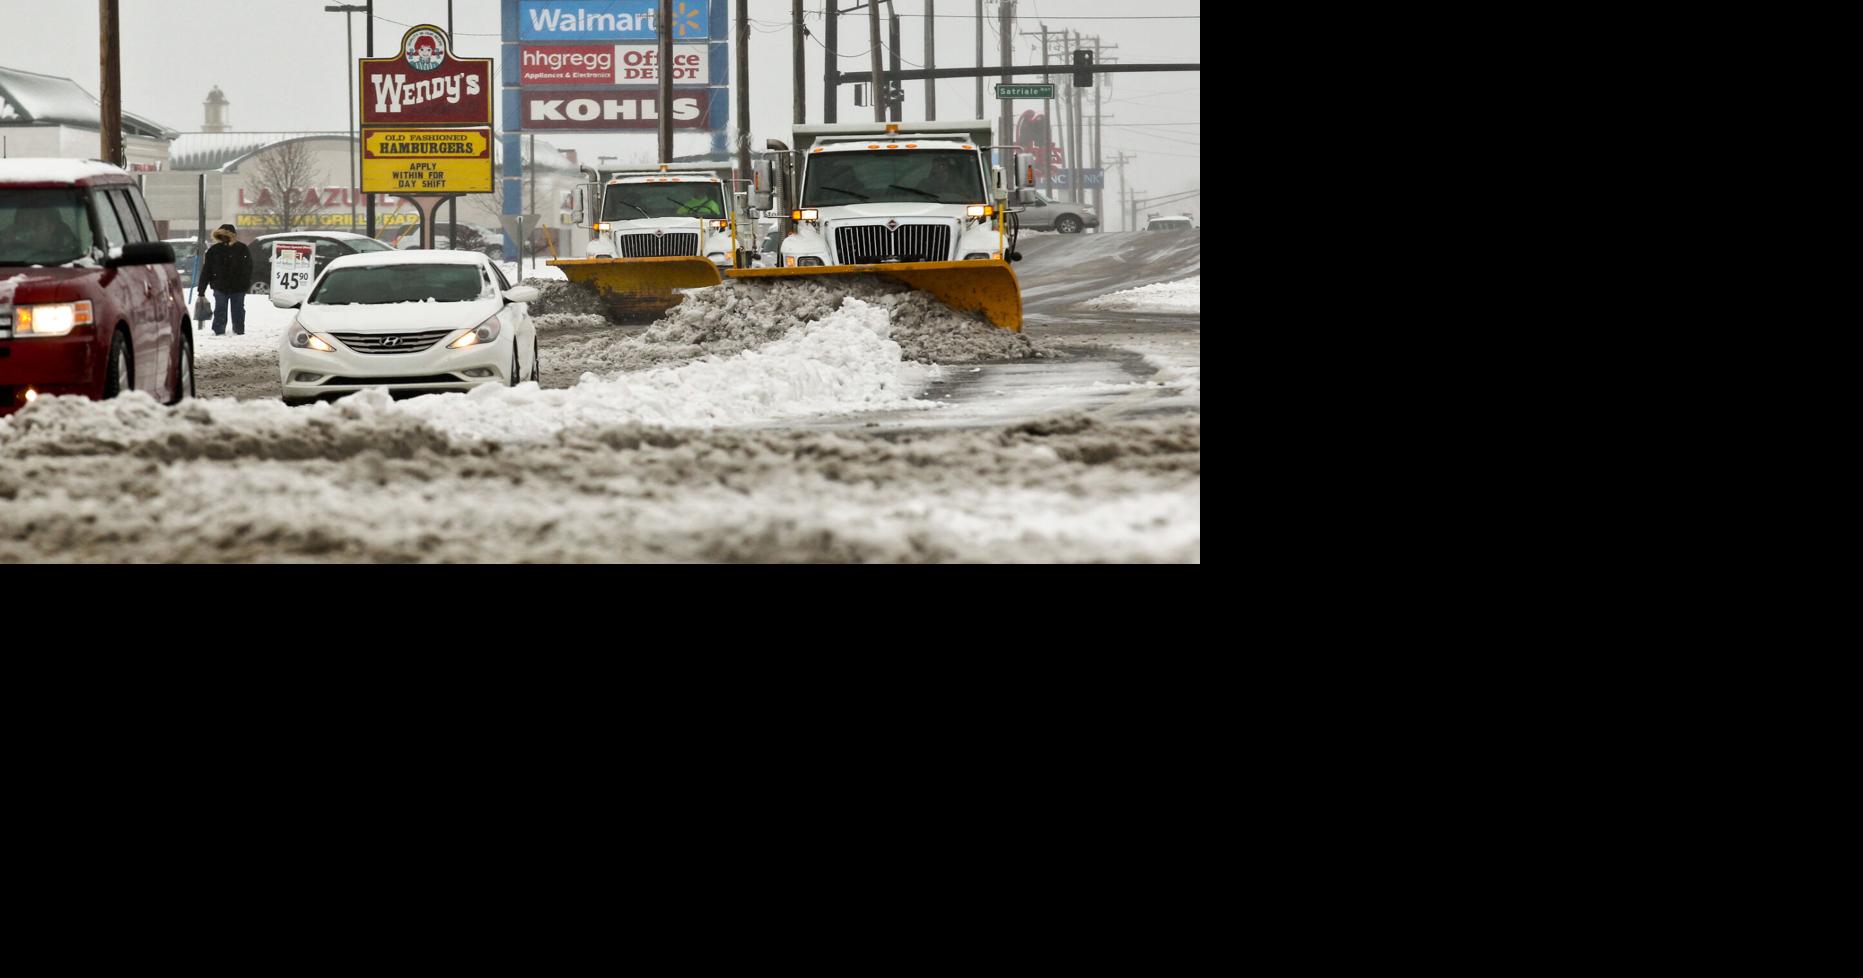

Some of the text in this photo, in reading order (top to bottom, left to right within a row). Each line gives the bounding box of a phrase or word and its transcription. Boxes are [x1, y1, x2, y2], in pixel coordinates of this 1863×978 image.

[529, 8, 657, 32] Walmart
[523, 50, 611, 70] hhgregg
[623, 50, 700, 66] Ofce
[524, 72, 563, 80] Appliances
[624, 67, 700, 79] DEOT
[371, 72, 481, 113] Wendy's
[1000, 87, 1039, 95] Satriale
[379, 142, 473, 154] HAMBURGERS
[409, 163, 437, 171] APPLY
[392, 171, 444, 179] WITHIN FOR
[398, 180, 446, 188] DAY SHIFT
[239, 188, 275, 208] LA
[237, 215, 317, 226] MEXAN
